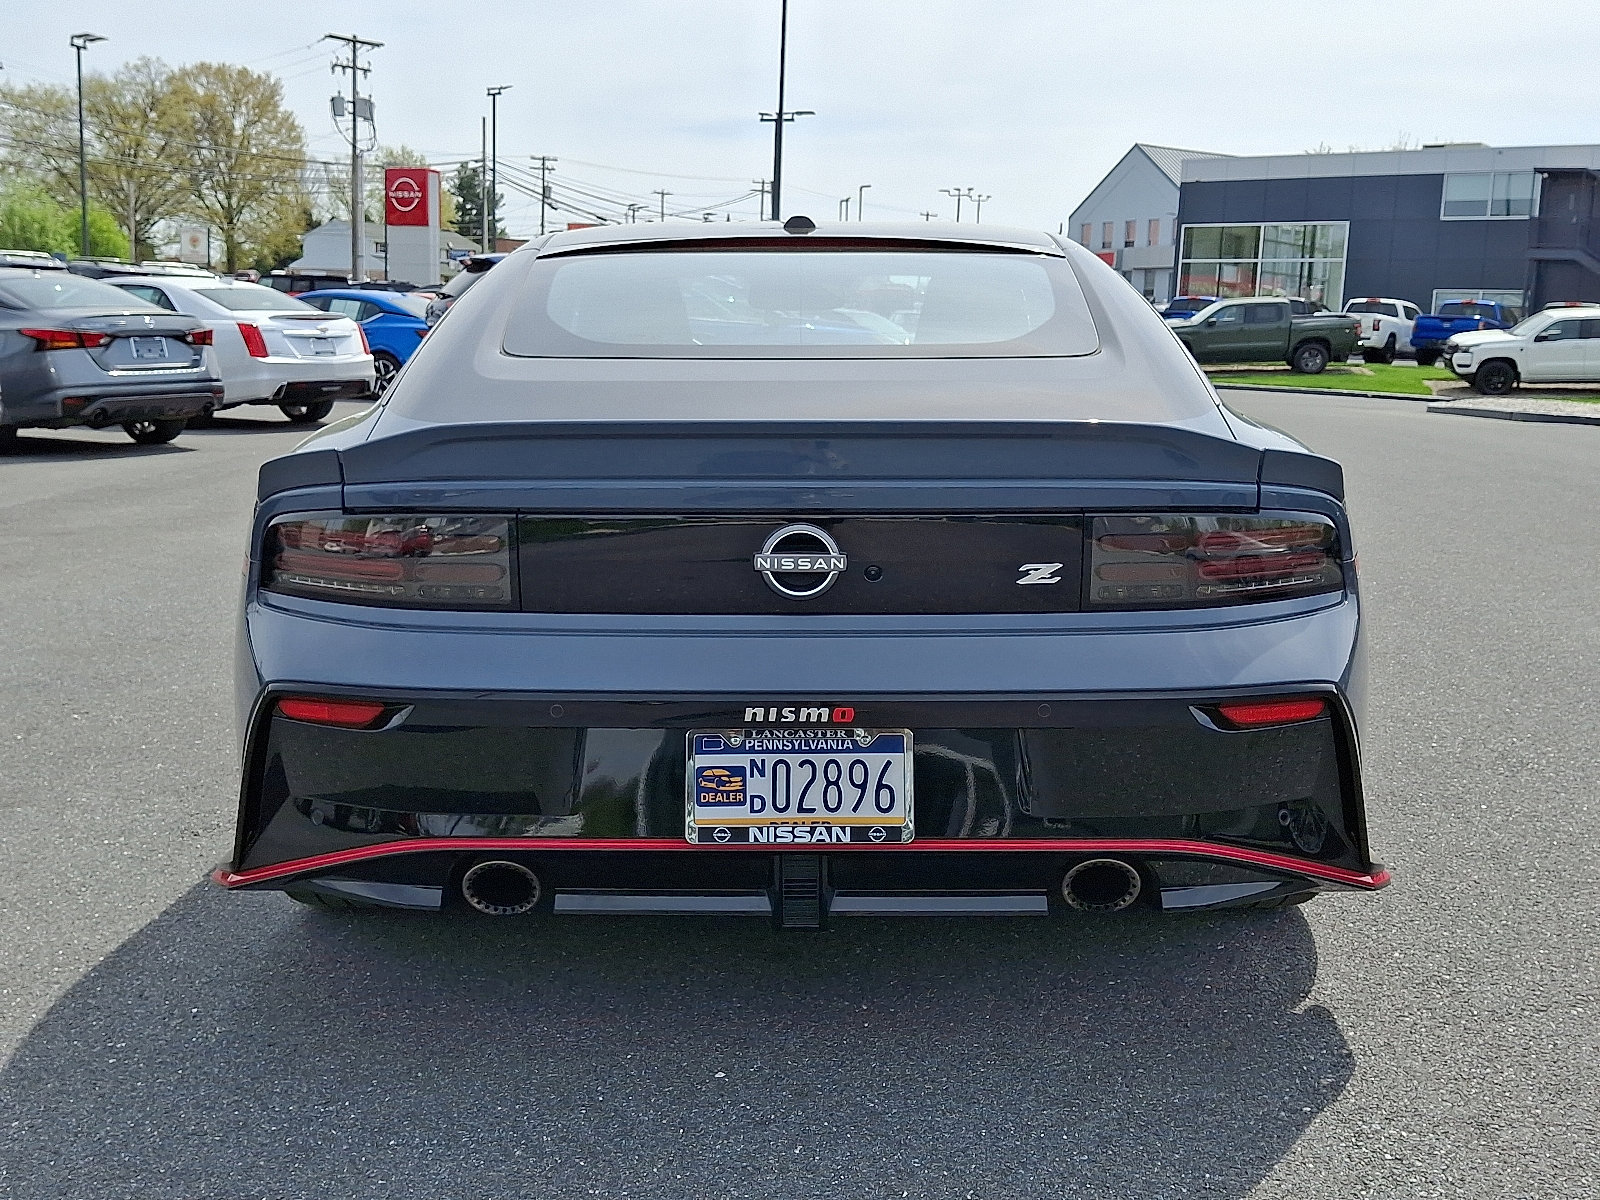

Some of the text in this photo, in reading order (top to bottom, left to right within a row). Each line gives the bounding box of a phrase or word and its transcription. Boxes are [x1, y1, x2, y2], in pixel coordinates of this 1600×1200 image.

[757, 557, 844, 570] NISSAN
[1016, 563, 1063, 584] Z
[751, 729, 848, 739] LANCASTER
[745, 739, 854, 751] PENNSYLVANIA
[771, 758, 896, 814] 02896
[700, 792, 744, 803] DEALER
[748, 826, 851, 843] NISSAN
